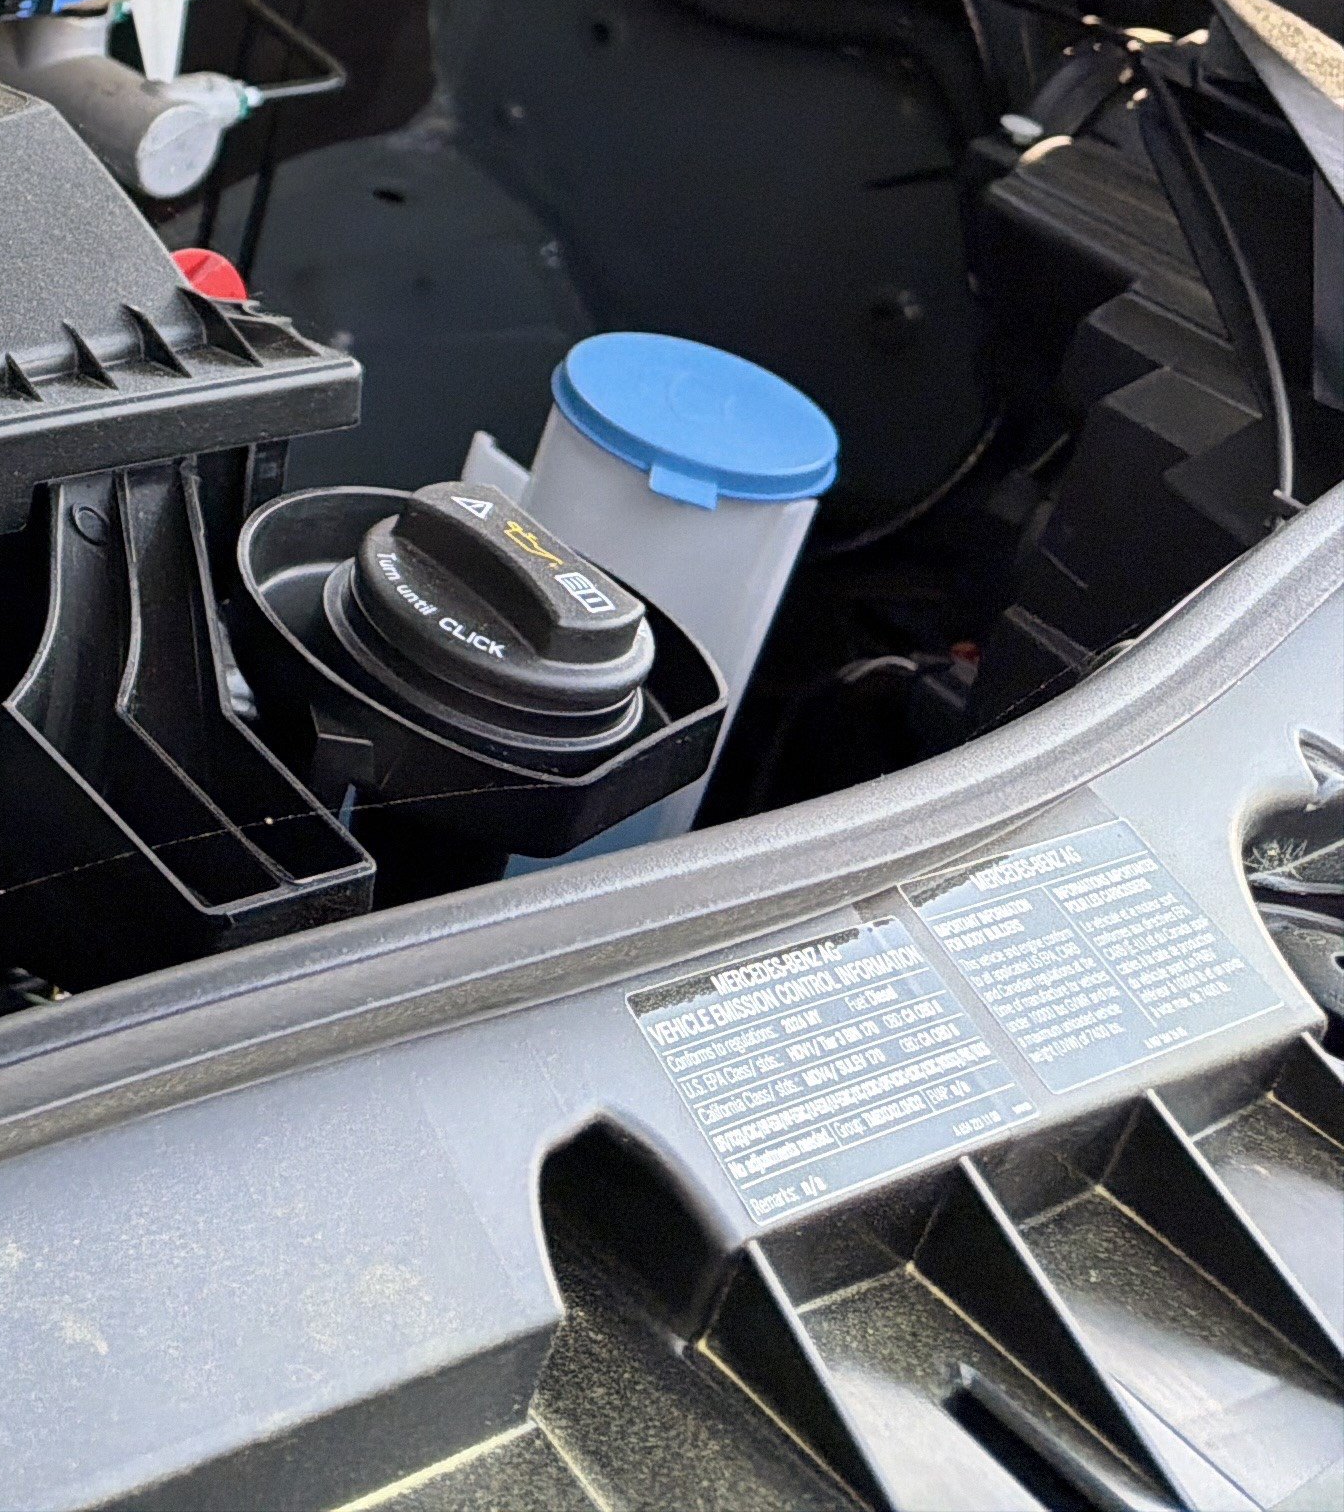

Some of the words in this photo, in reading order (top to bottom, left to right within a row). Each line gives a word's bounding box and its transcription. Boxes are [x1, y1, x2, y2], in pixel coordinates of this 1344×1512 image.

[376, 551, 401, 582] Turn
[396, 583, 438, 616] until
[438, 617, 506, 659] CLICK
[968, 848, 1067, 892] MERCEDES-BENZ
[1057, 844, 1082, 865] AG
[645, 1007, 716, 1046] VEHICLE
[706, 986, 781, 1027] EMISSION
[773, 969, 843, 1005] CONTROL
[832, 943, 925, 986] INFORMATION
[709, 945, 824, 997] MERCEDES-BENZ
[816, 940, 844, 964] AG
